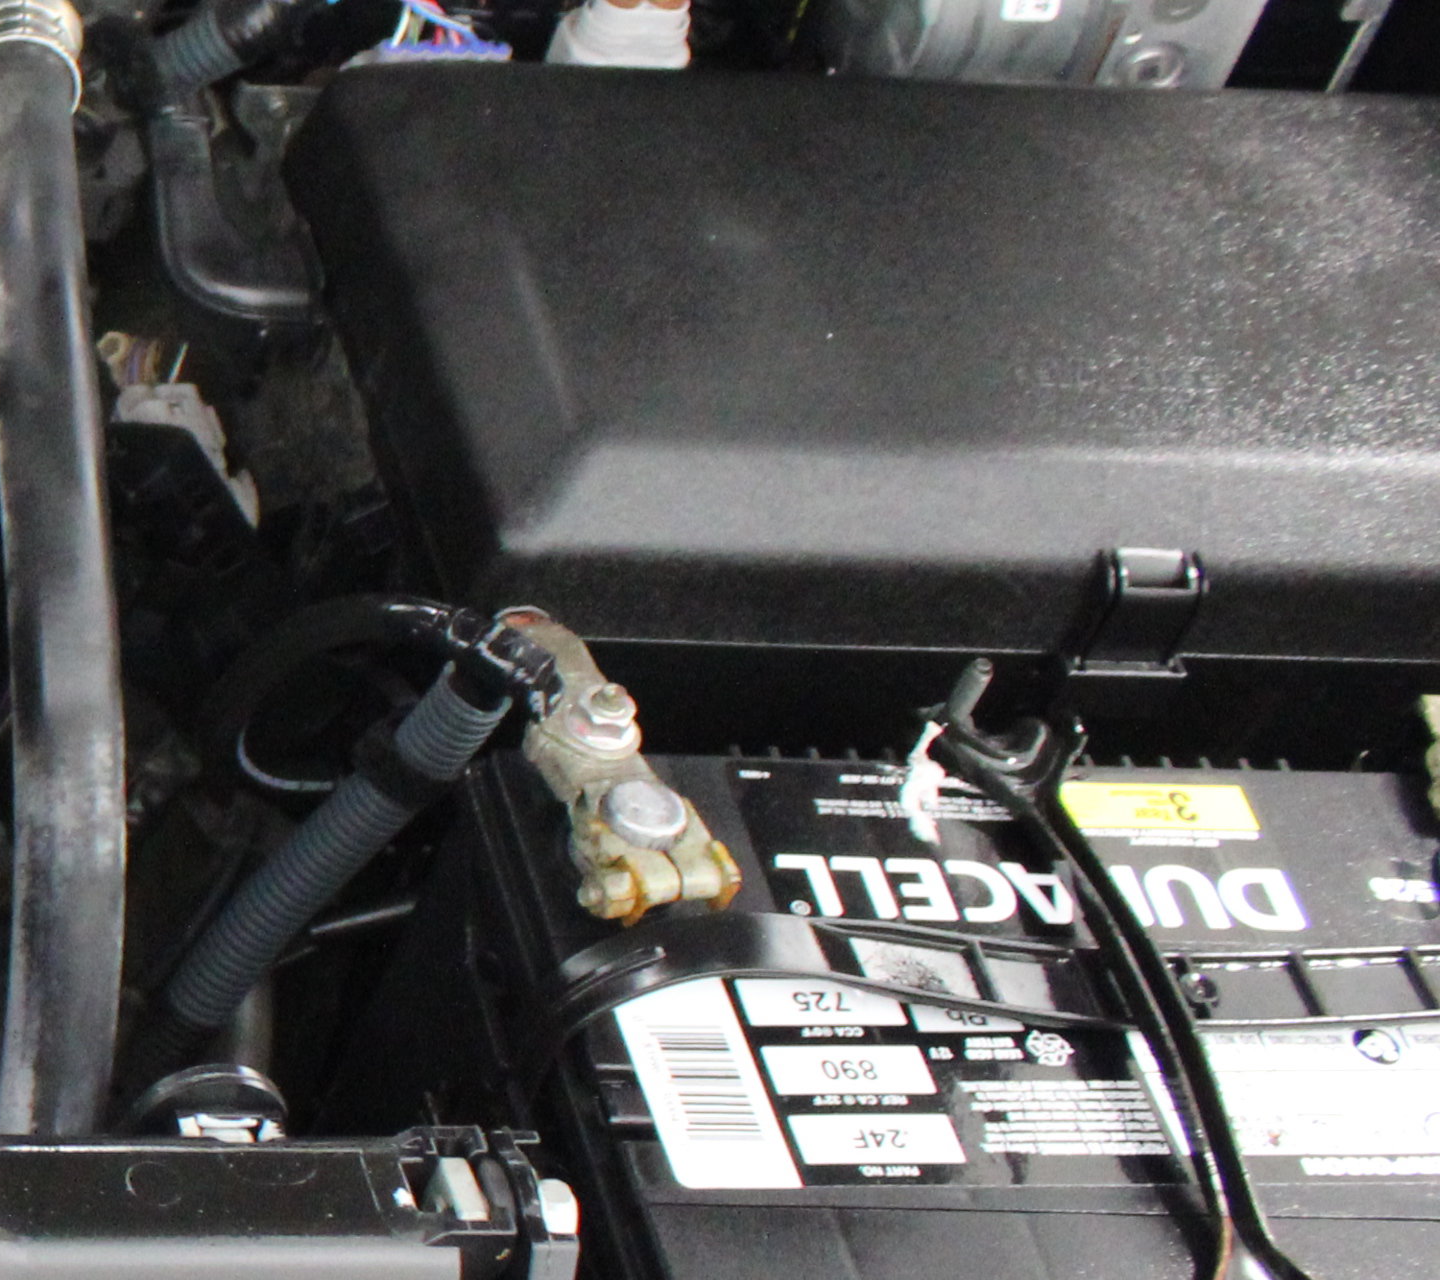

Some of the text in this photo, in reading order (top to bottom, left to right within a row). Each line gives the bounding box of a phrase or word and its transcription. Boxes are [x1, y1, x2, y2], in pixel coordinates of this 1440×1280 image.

[773, 854, 1309, 933] DUACELL
[792, 991, 852, 1013] 725
[928, 1047, 954, 1060] 12V
[821, 1059, 878, 1081] 890
[852, 1128, 906, 1150] 24F
[858, 1164, 921, 1178] PART NO.
